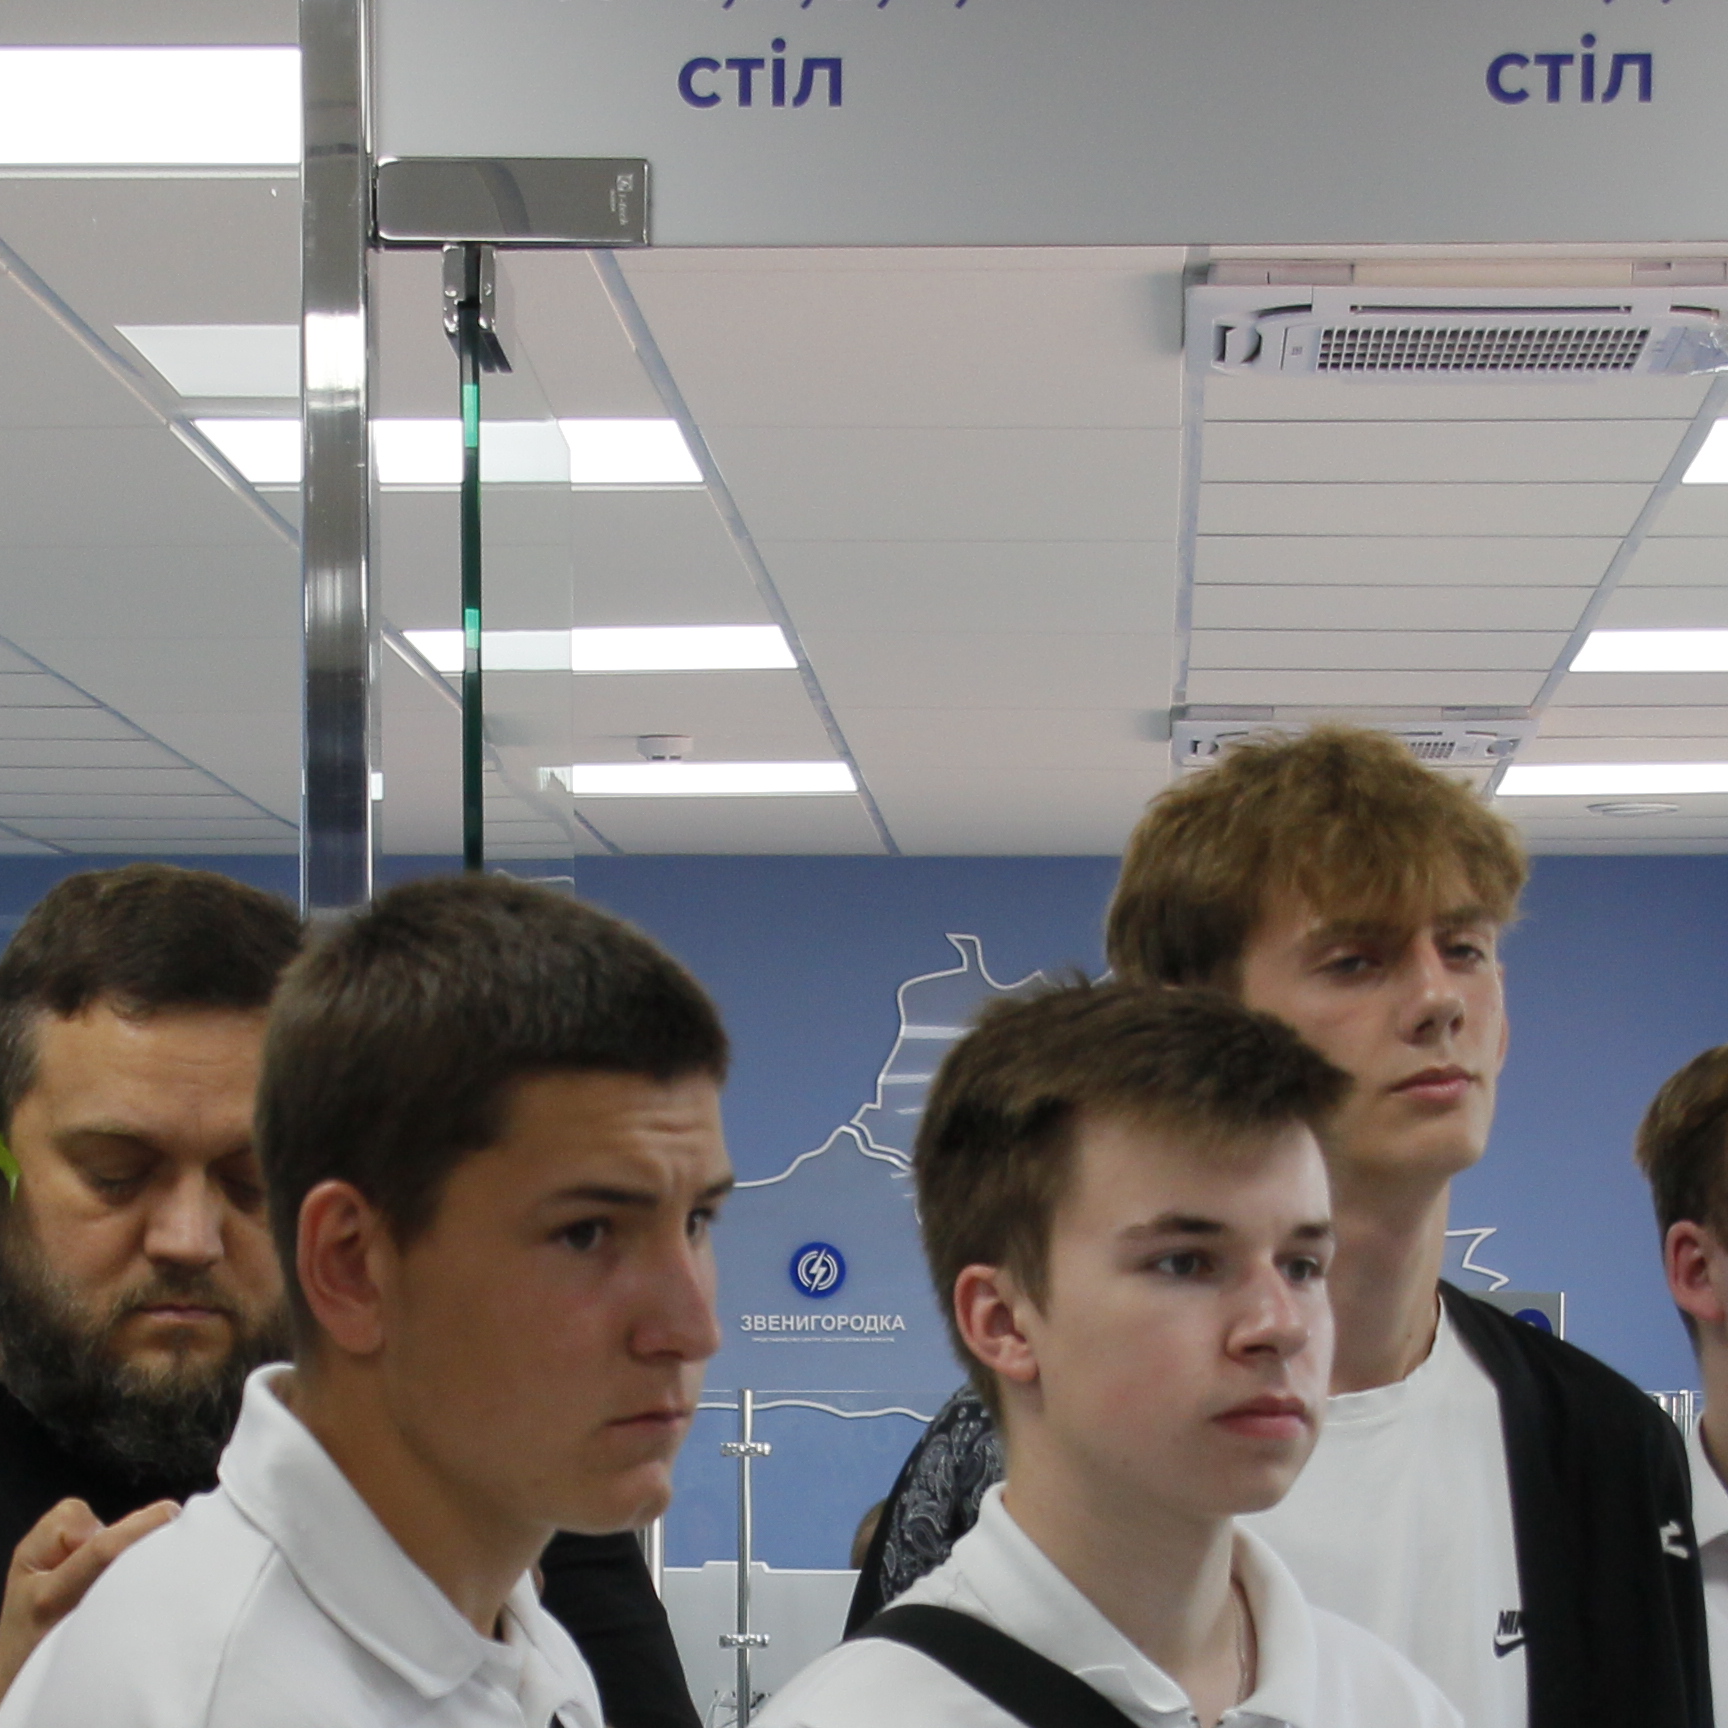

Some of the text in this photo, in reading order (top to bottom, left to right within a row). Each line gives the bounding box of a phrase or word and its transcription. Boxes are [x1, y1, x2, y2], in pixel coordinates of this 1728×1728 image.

[677, 37, 843, 108] стіл
[1485, 32, 1652, 104] стіл
[740, 1314, 906, 1333] ЗВЕНИГОРОДКА
